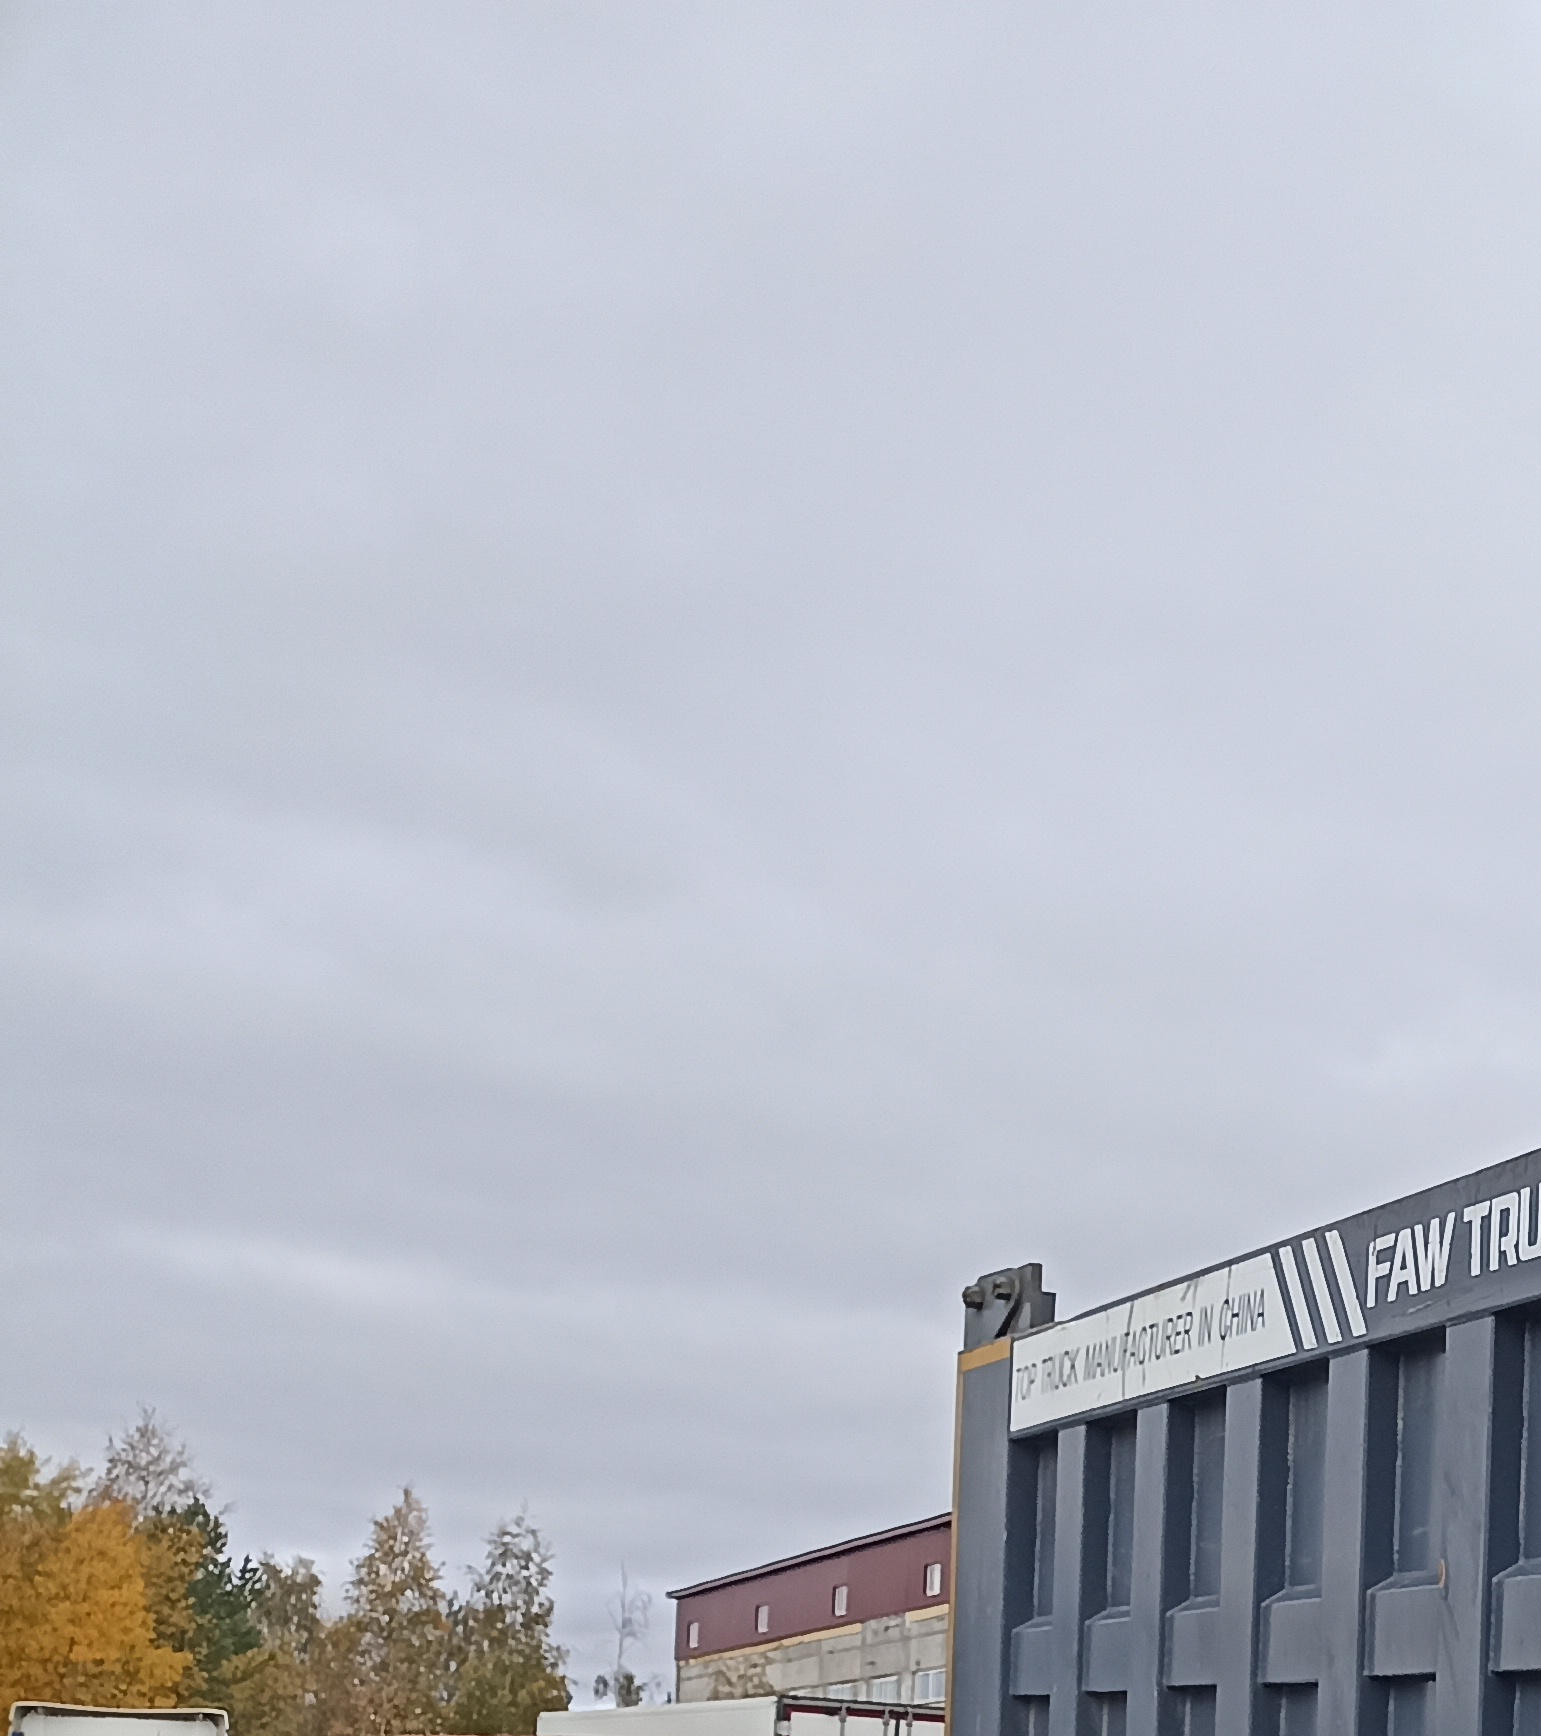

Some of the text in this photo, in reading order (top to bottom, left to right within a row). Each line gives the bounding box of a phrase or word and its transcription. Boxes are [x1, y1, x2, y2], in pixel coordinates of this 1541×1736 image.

[1366, 1211, 1456, 1309] FAW
[1014, 1288, 1266, 1402] TOP TRUCK MANUFACTURER IN CHINA
